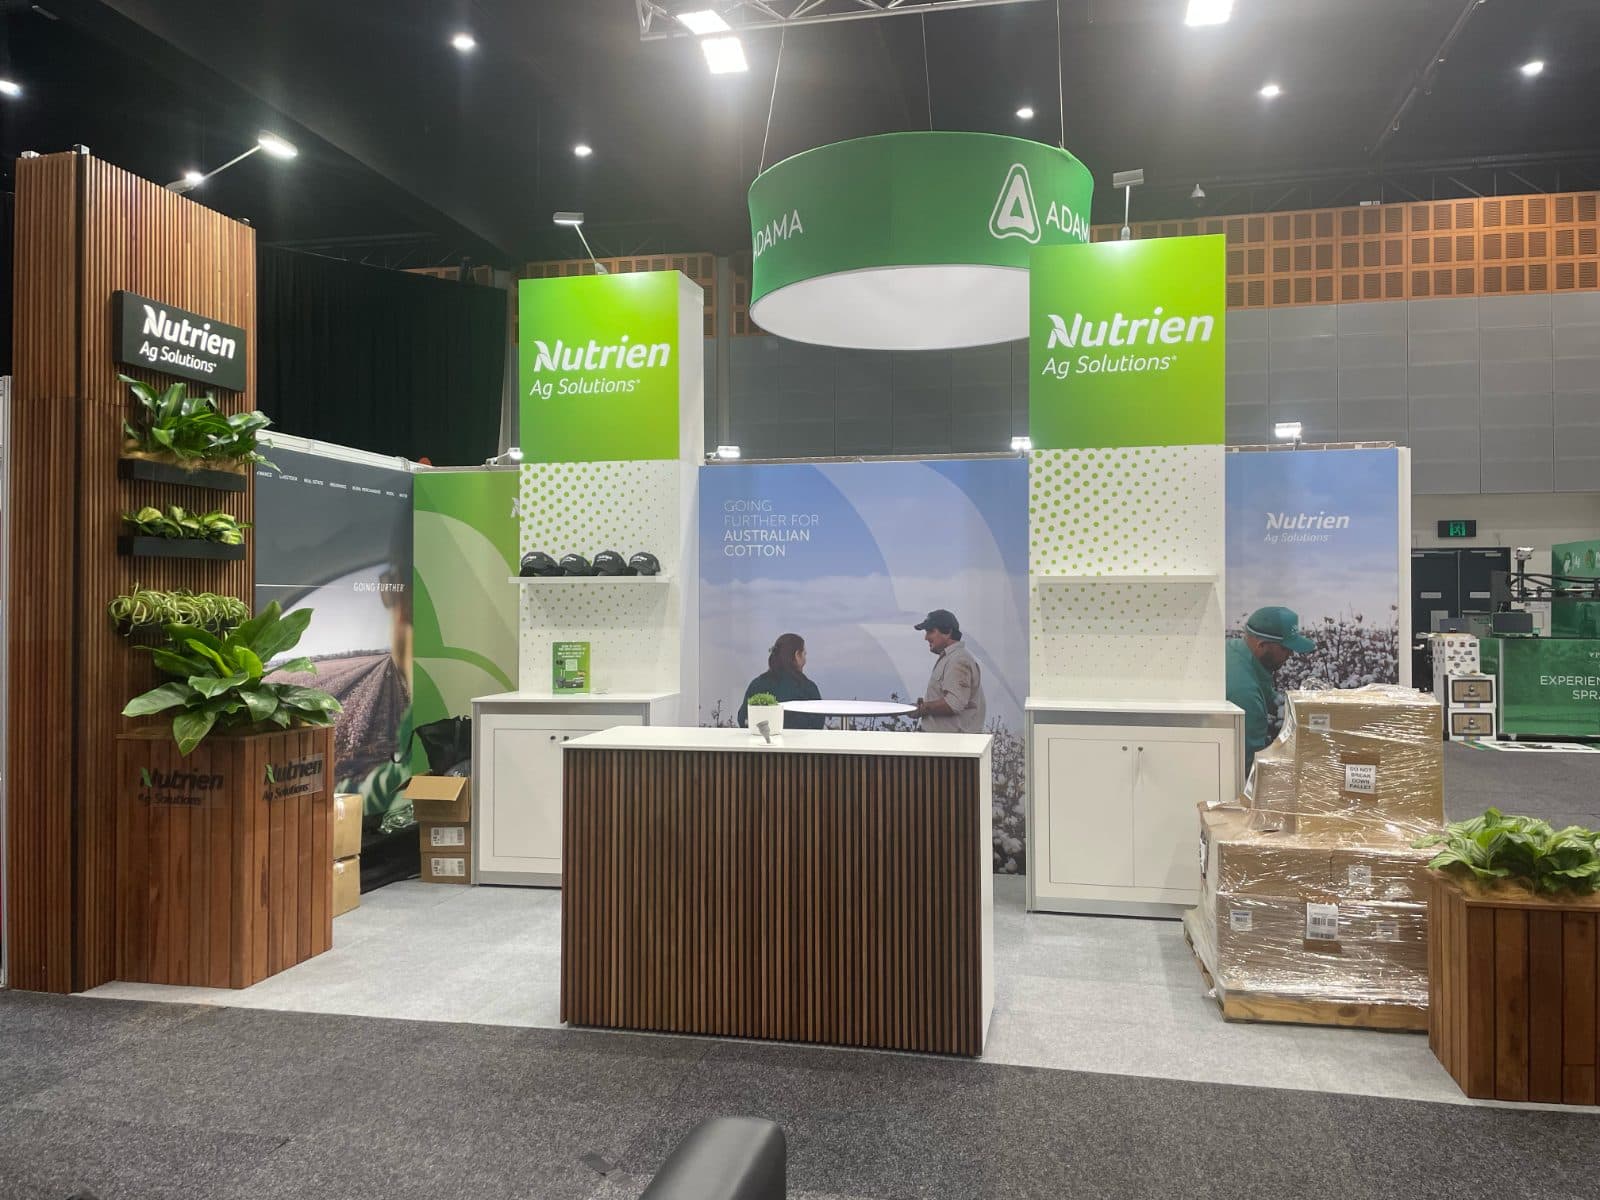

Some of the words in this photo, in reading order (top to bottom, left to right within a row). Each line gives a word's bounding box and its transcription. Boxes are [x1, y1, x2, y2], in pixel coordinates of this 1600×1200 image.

[143, 304, 236, 359] Nutrien
[1047, 306, 1214, 349] Nutrien
[139, 341, 159, 362] Ag
[160, 345, 215, 374] Solutions
[533, 335, 671, 372] Nutrien
[1042, 357, 1070, 380] Ag
[1075, 353, 1172, 374] Solutions
[529, 379, 553, 400] Ag
[557, 377, 636, 395] Solutions
[723, 500, 772, 512] GOING
[724, 514, 786, 527] FURTHER
[791, 514, 820, 527] FOR
[1266, 510, 1350, 529] Nutrien
[724, 529, 810, 541] AUSTRALIAN
[1264, 533, 1279, 544] Ag
[724, 545, 786, 557] COTTON
[353, 583, 376, 592] GOING
[1572, 690, 1600, 700] SPR
[140, 766, 224, 790] Nutrien
[264, 756, 322, 785] Nutrien
